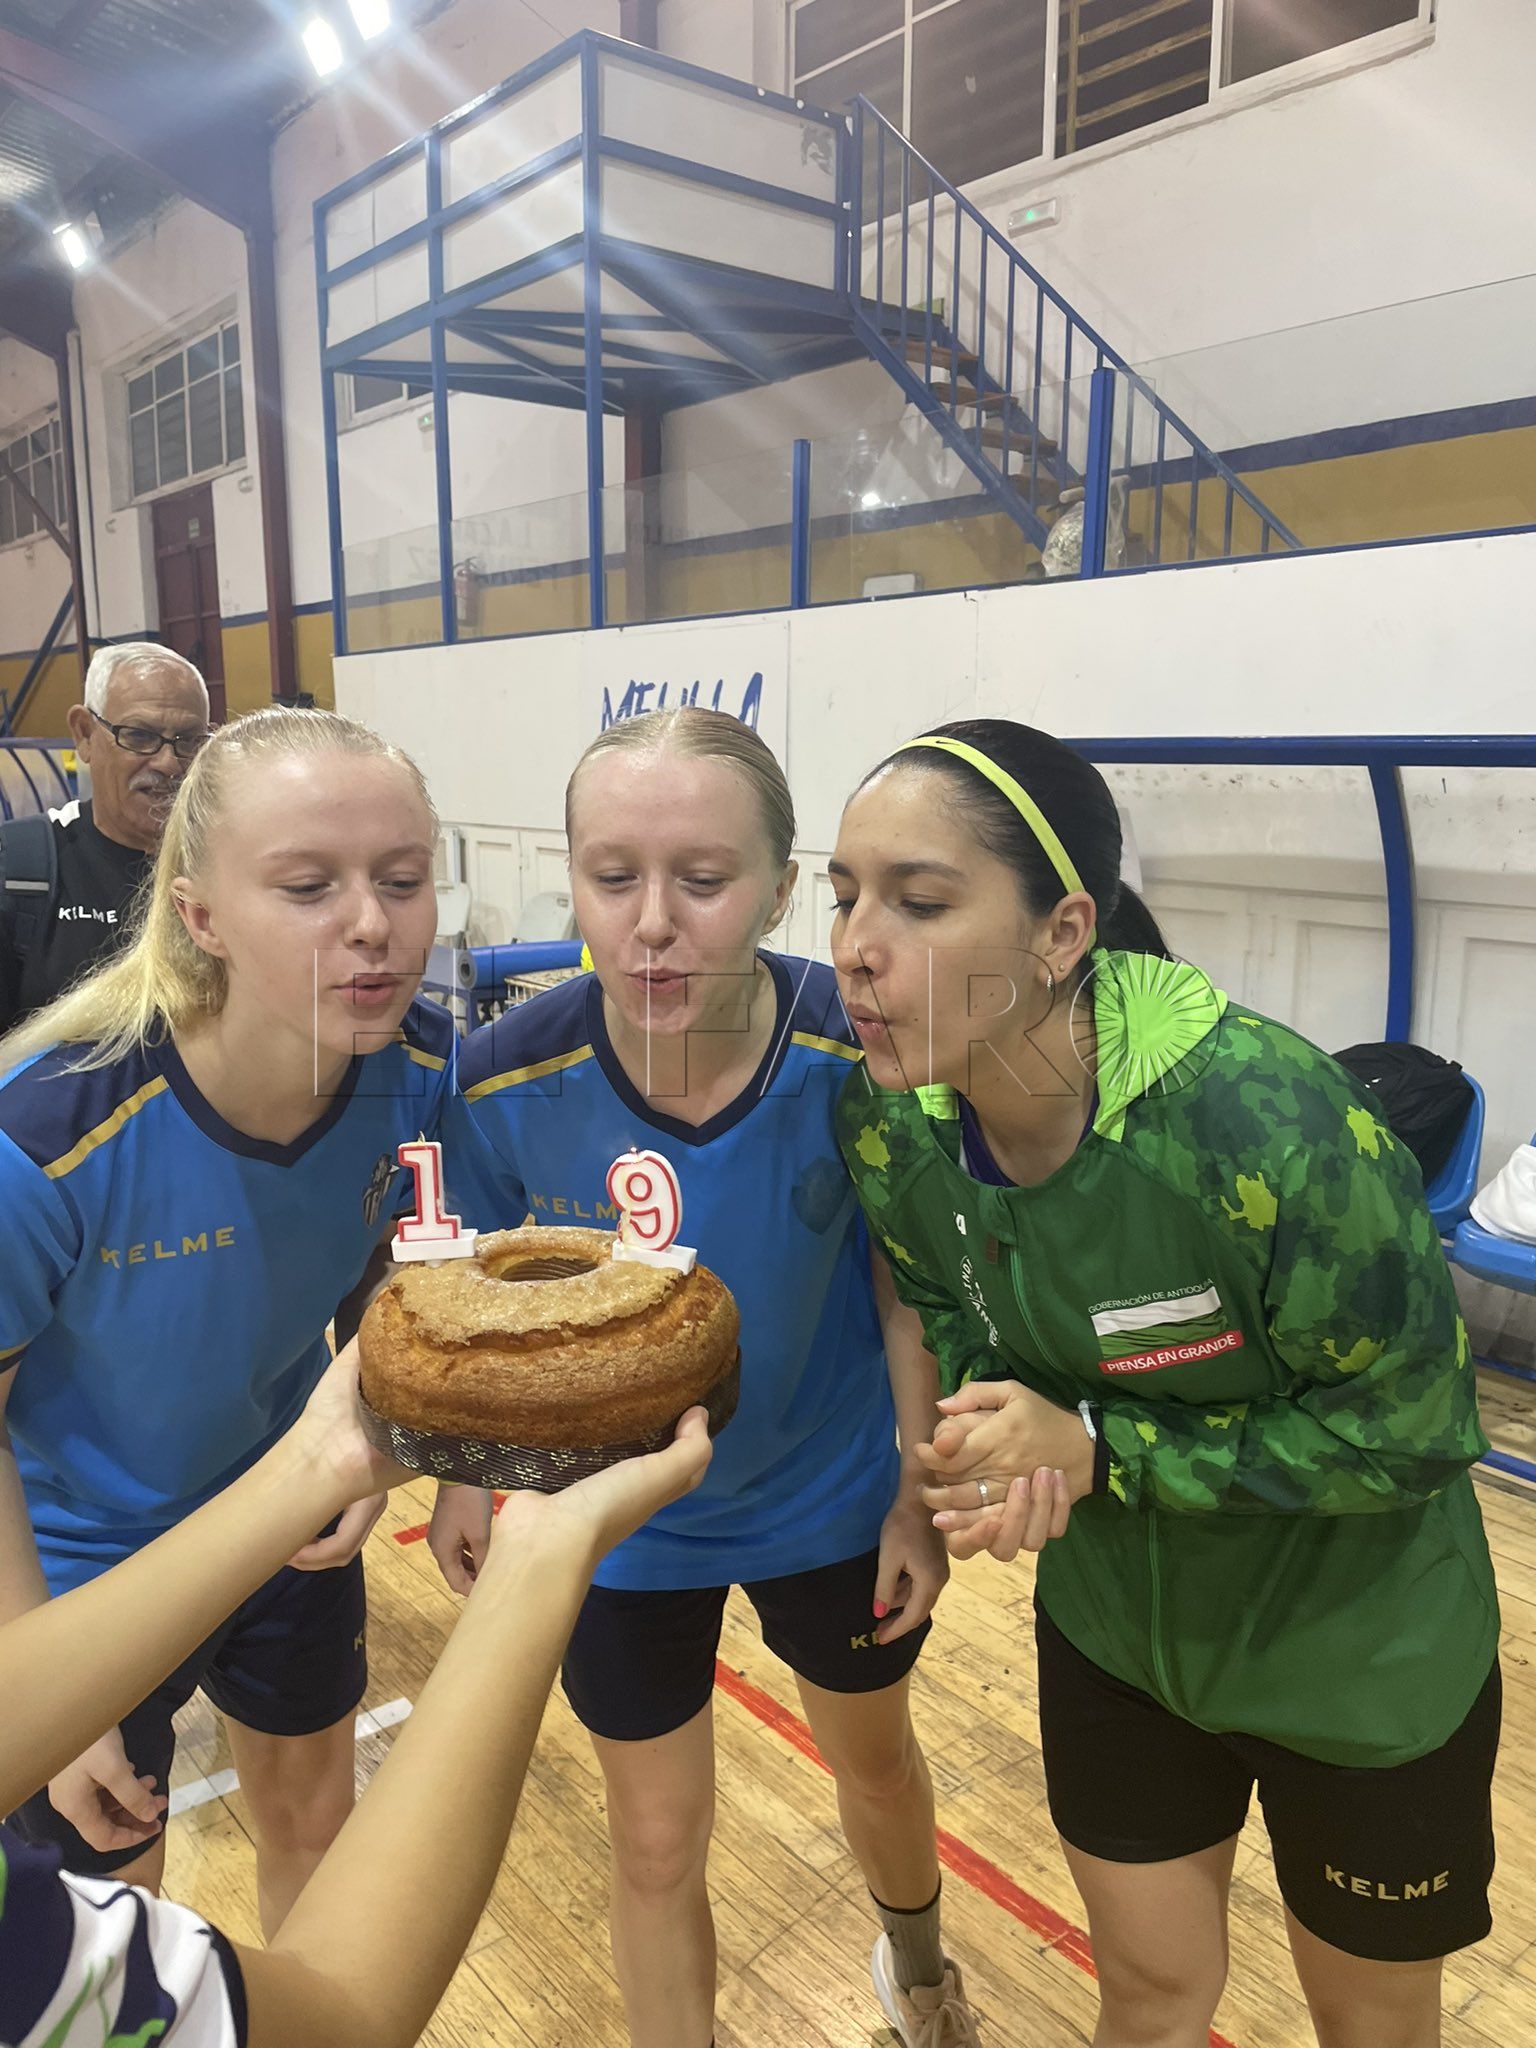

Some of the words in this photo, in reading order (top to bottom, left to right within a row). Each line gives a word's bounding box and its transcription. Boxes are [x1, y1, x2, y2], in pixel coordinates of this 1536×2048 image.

[532, 1193, 618, 1220] KELM
[101, 1226, 236, 1269] KELME
[1088, 1294, 1151, 1315] GOBERNACIÓN
[1153, 1291, 1166, 1301] DE
[1107, 1356, 1157, 1373] PIENSA
[1157, 1351, 1178, 1365] EN
[1178, 1334, 1237, 1360] GRANDE
[1325, 1863, 1450, 1901] KELME
